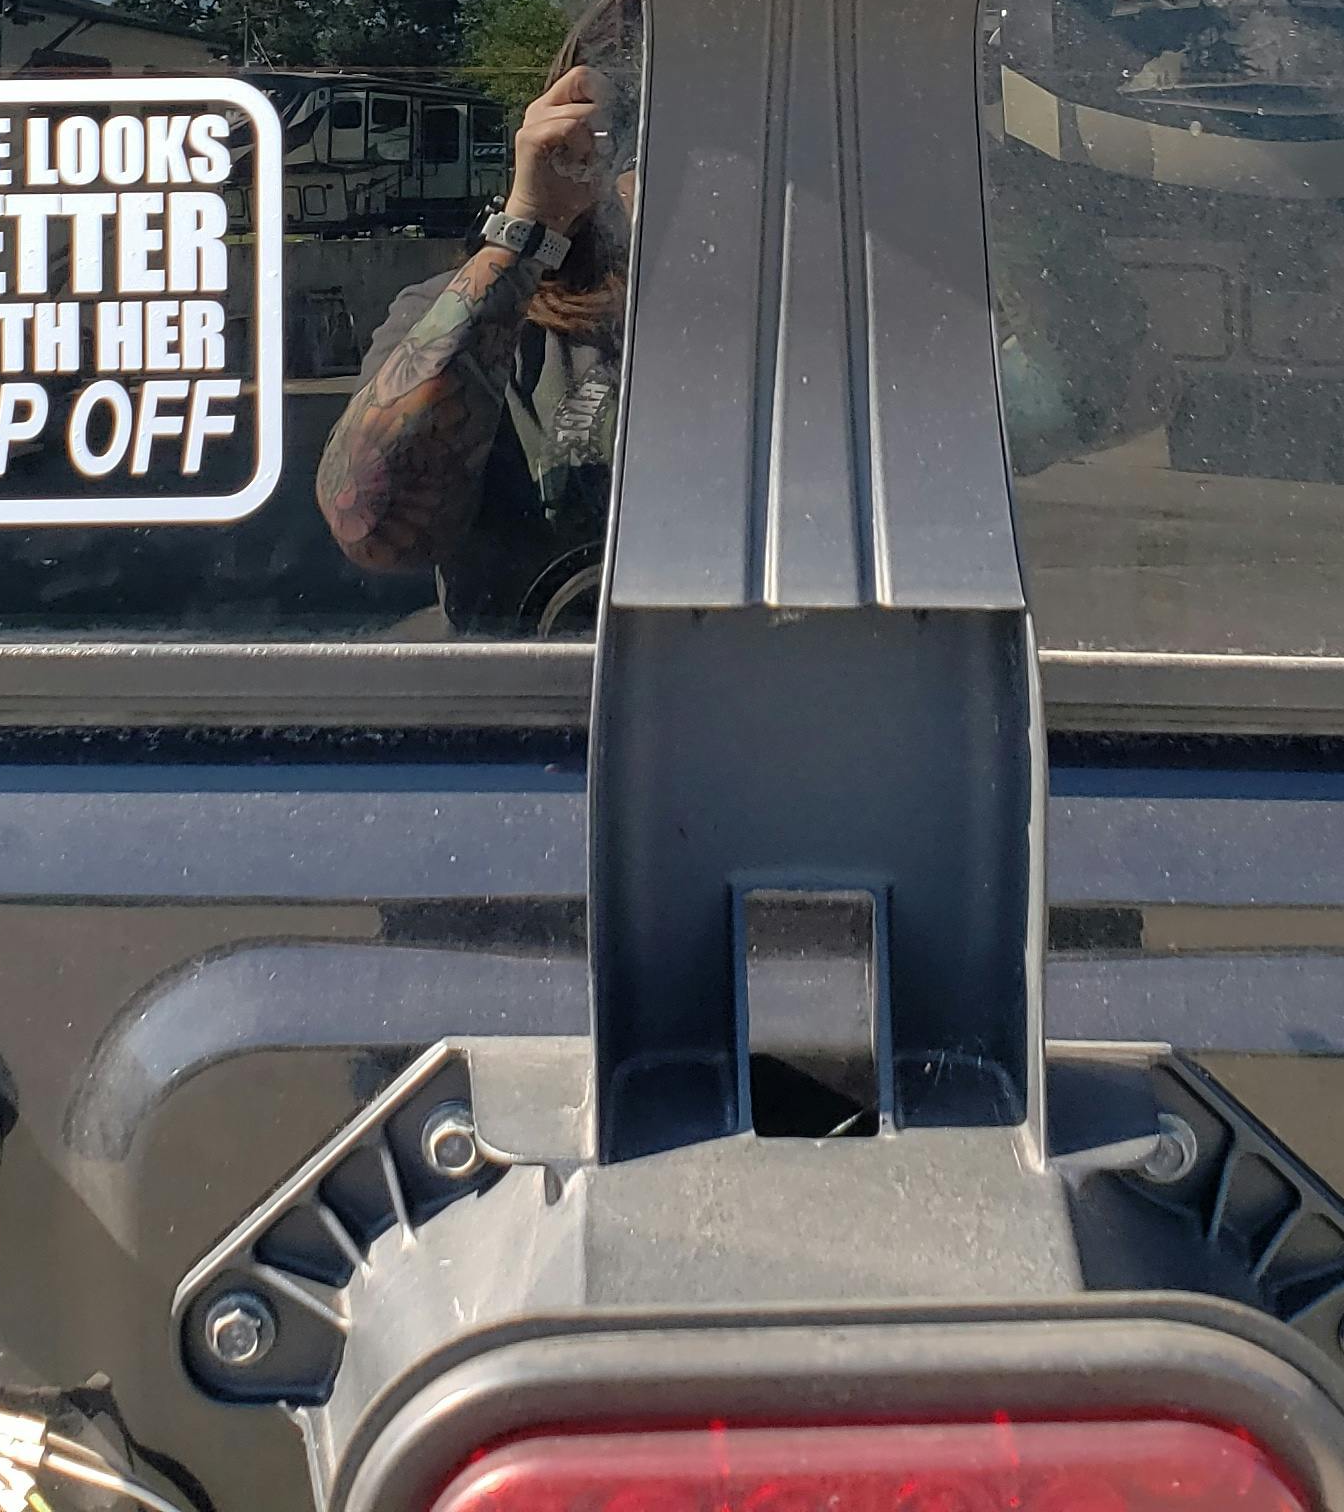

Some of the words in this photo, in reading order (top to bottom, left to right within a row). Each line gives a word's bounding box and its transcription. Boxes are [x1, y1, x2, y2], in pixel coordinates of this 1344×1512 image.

[26, 113, 233, 186] LOOKS
[97, 300, 226, 372] HER
[68, 379, 242, 476] OFF
